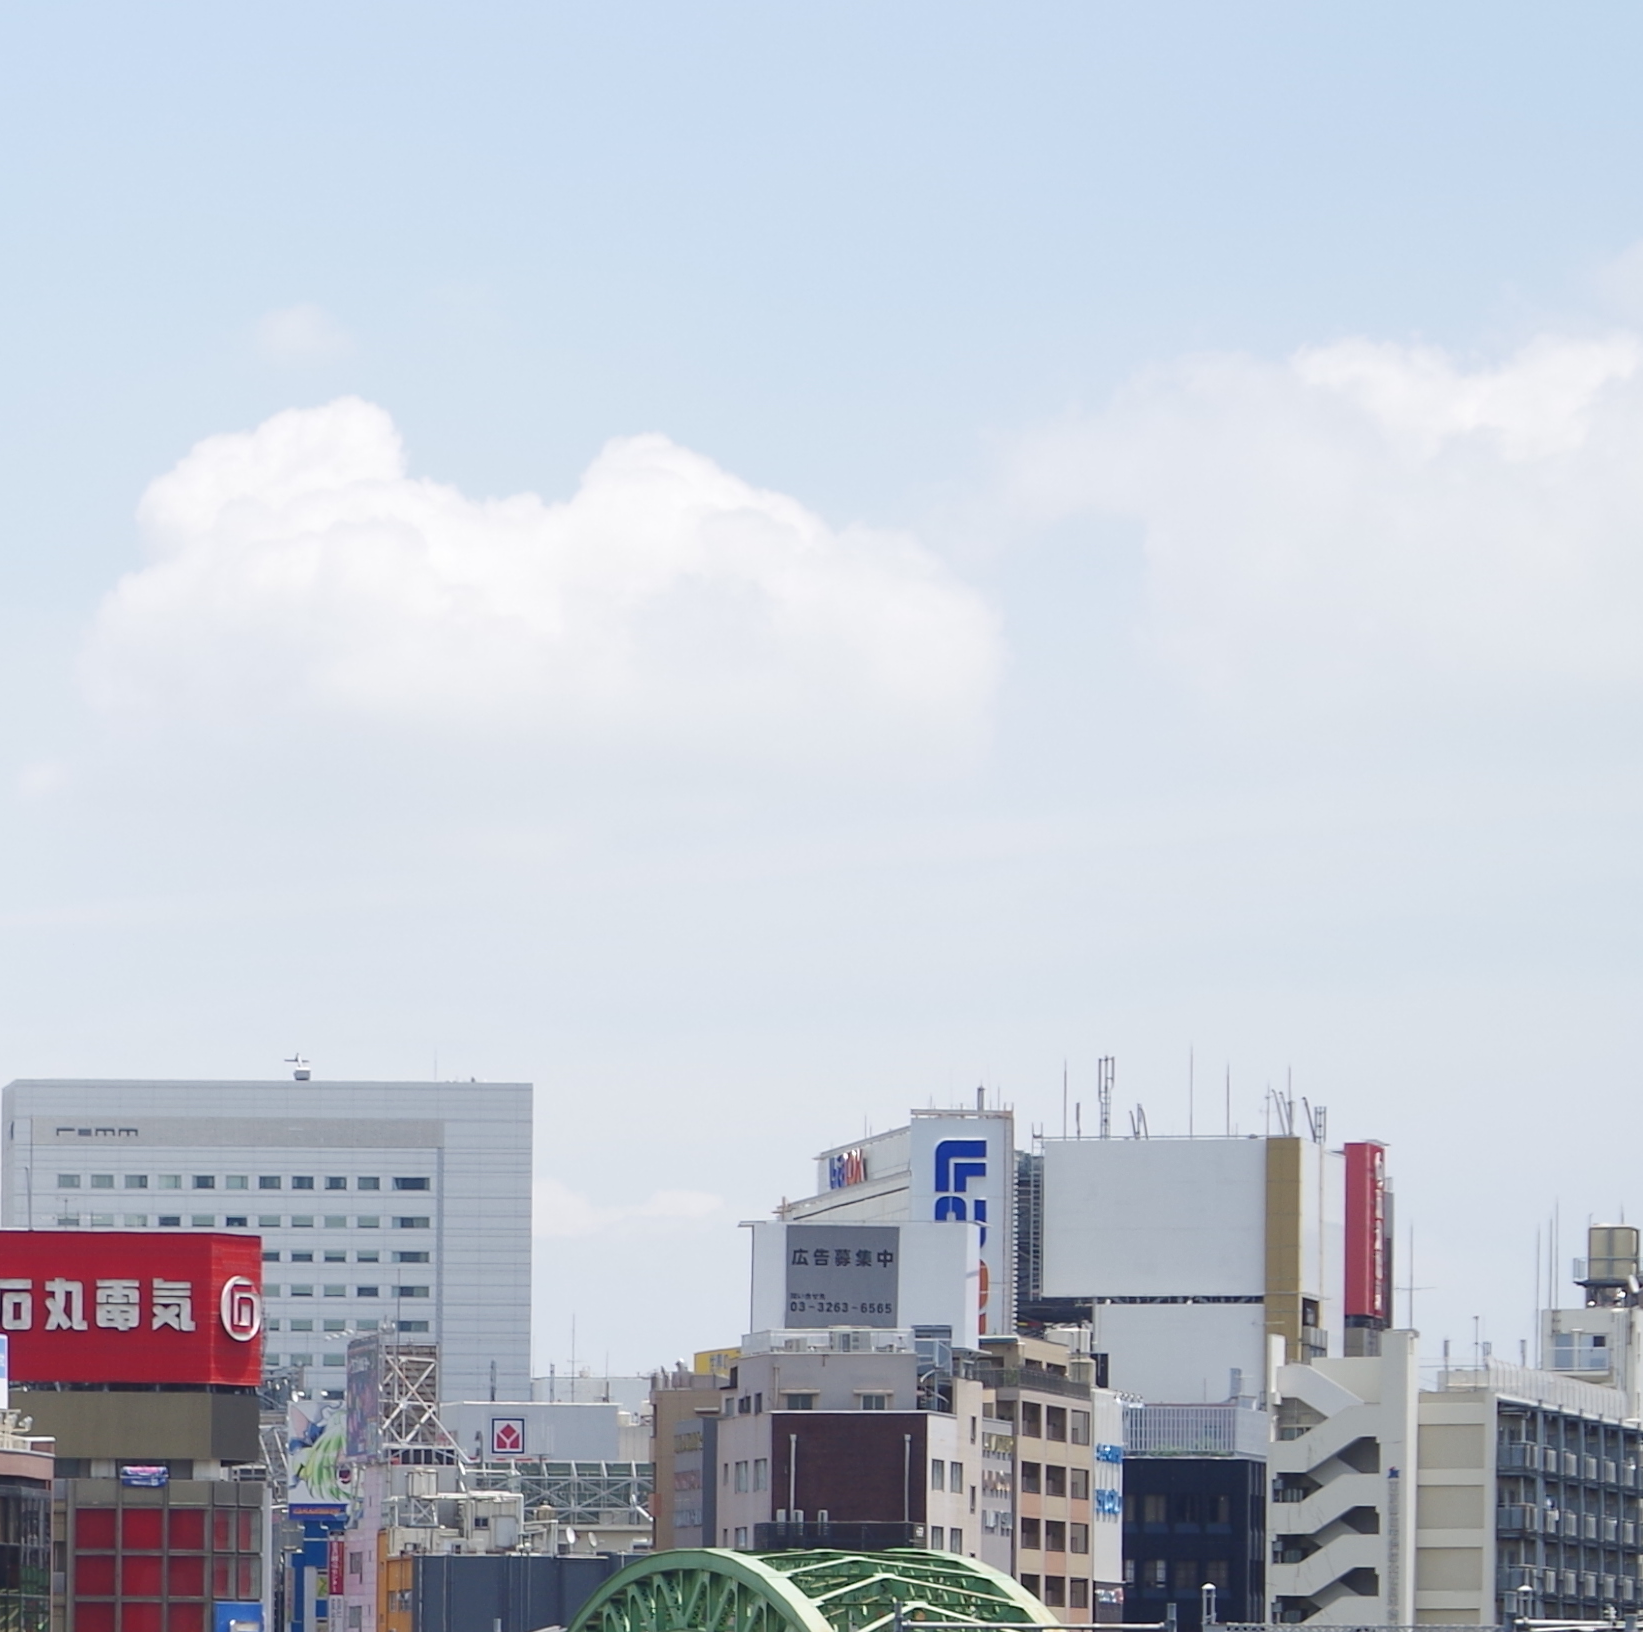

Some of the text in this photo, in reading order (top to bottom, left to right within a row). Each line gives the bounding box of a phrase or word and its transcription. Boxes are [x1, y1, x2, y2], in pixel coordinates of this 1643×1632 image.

[791, 1248, 894, 1268] 広告募集中
